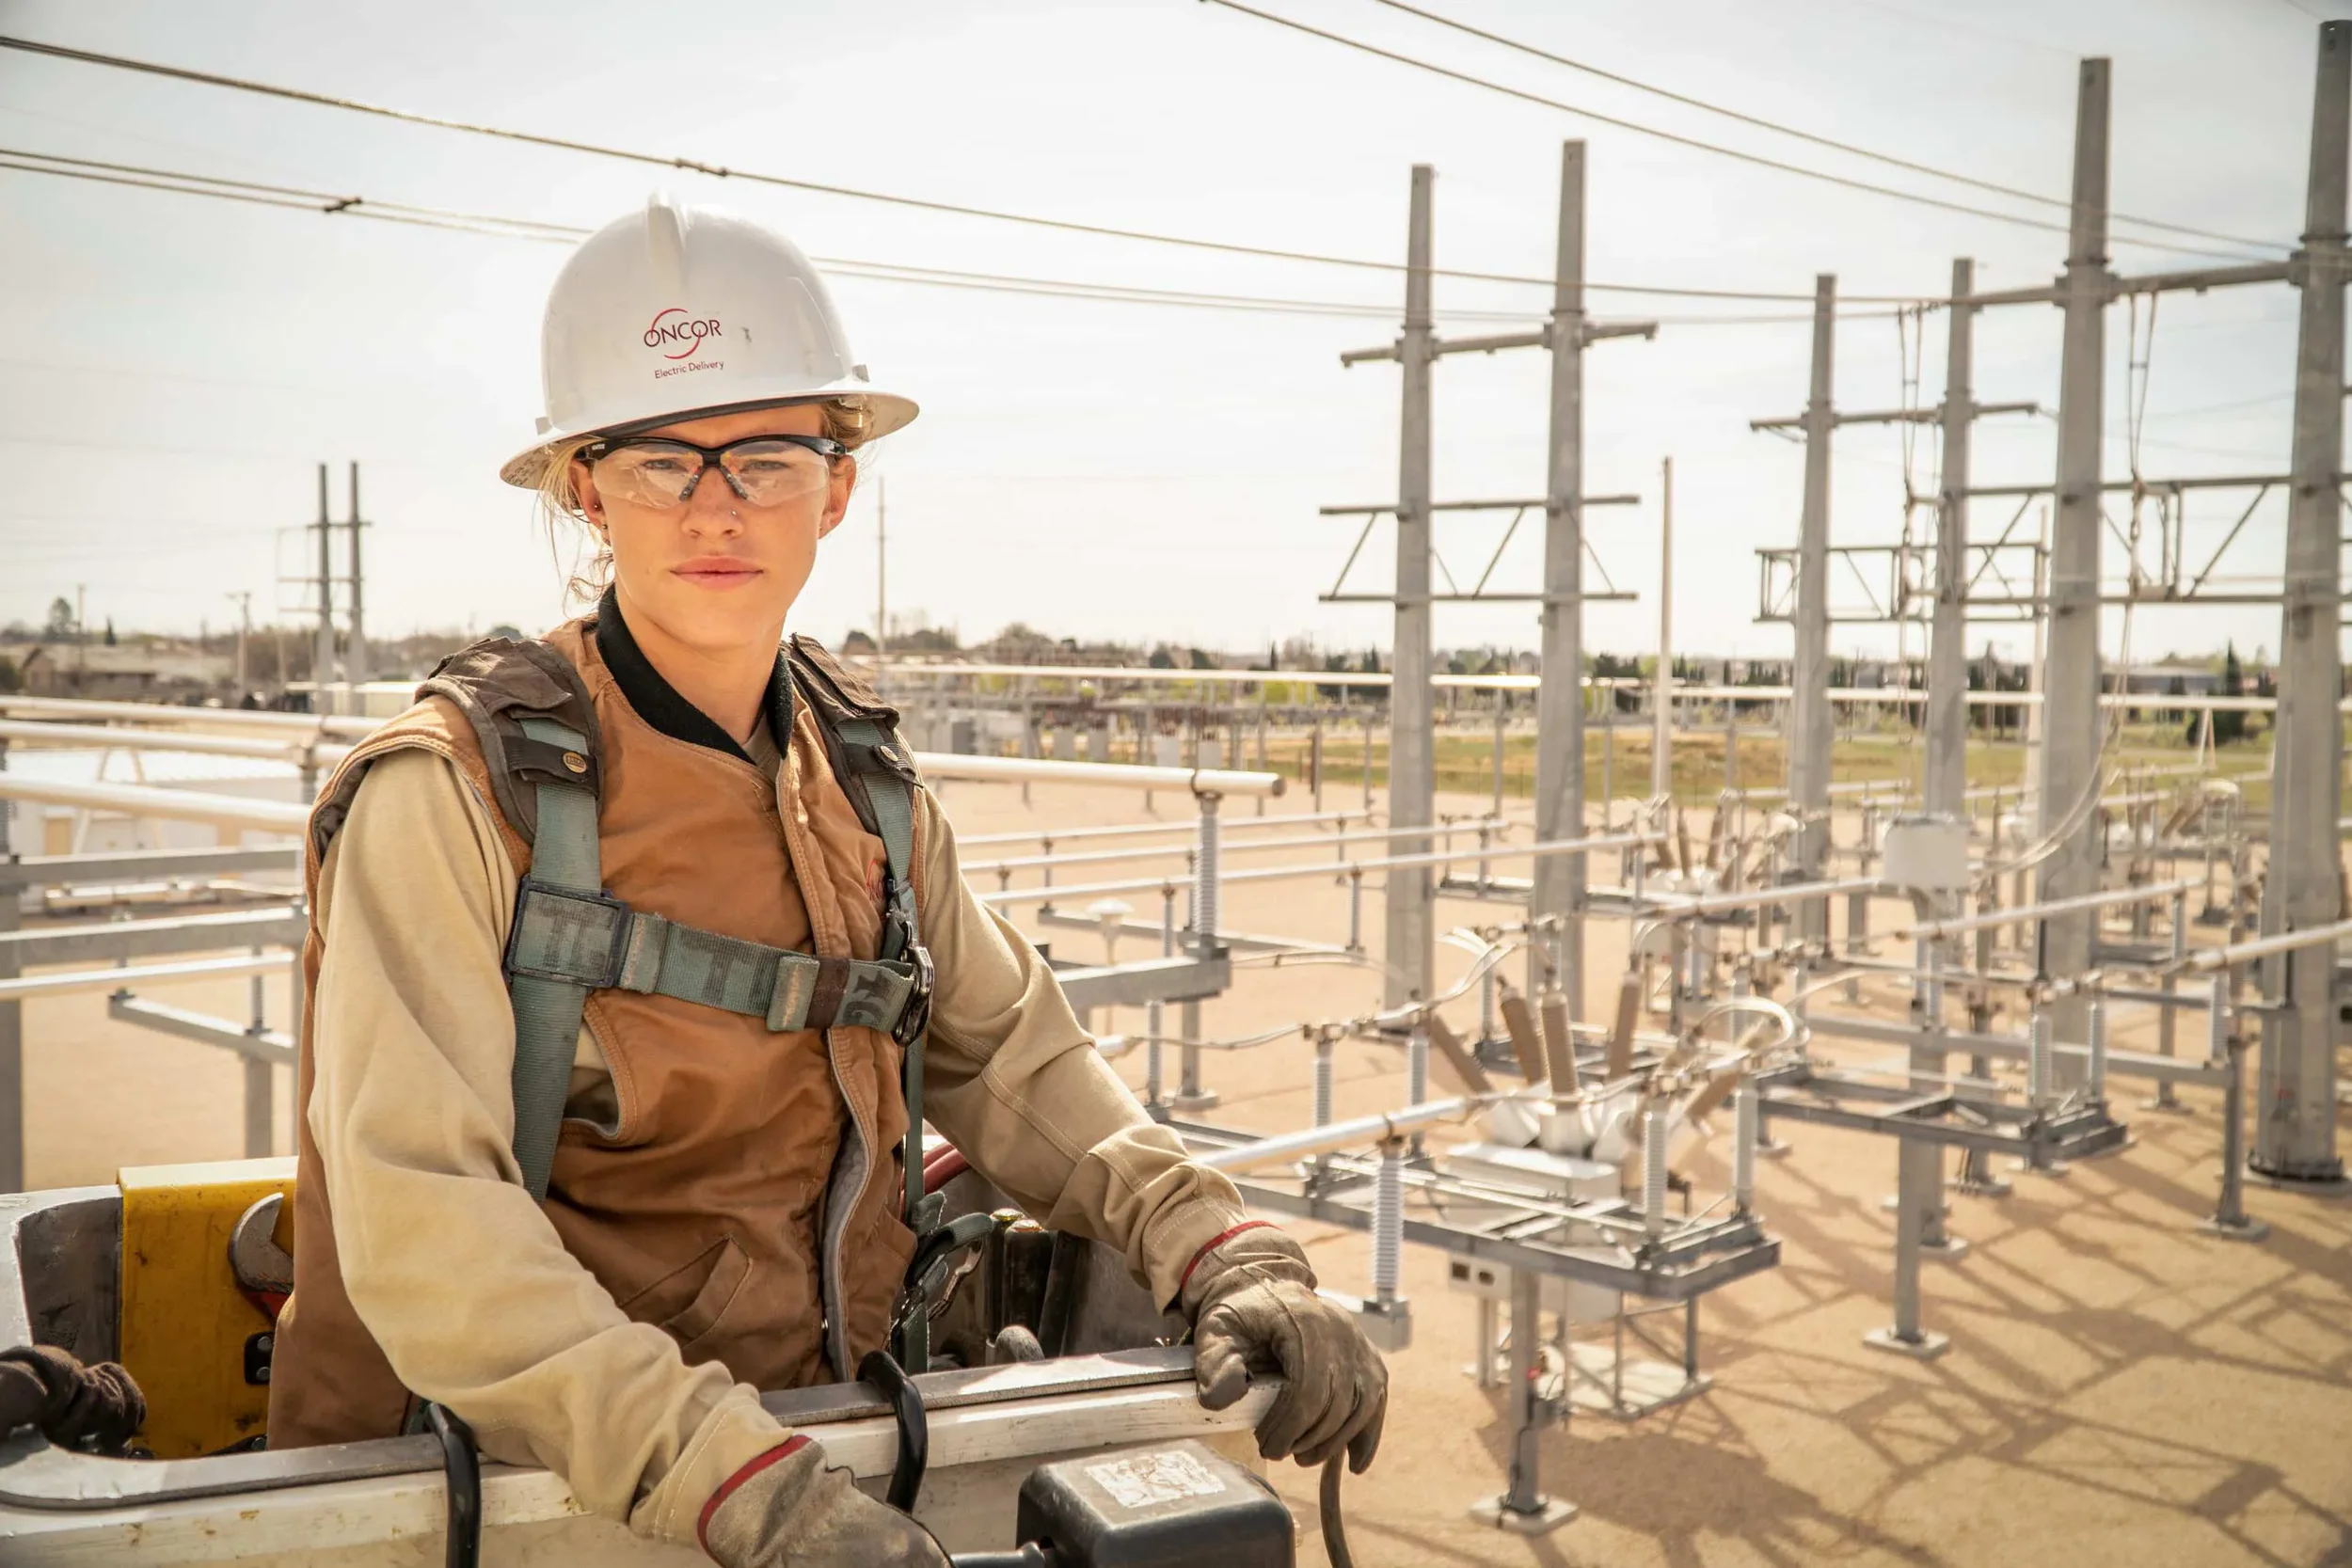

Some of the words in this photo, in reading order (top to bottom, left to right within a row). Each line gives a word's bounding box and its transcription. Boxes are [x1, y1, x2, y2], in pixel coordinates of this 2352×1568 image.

[644, 319, 722, 347] ONCOR
[654, 365, 687, 378] Electric
[688, 360, 724, 372] Delivery
